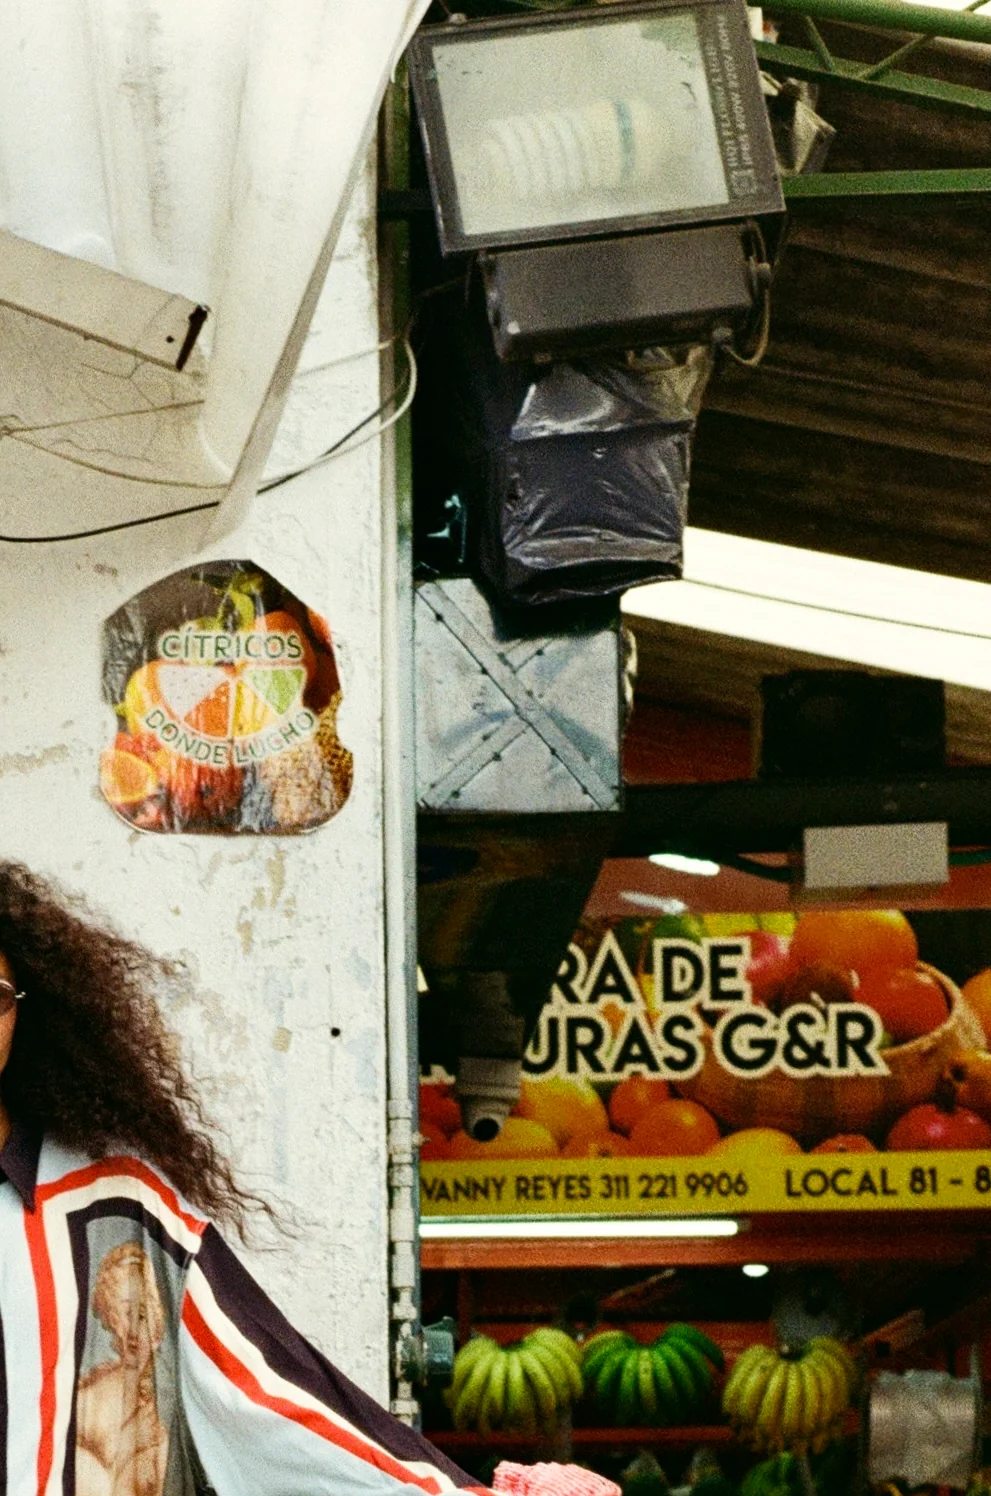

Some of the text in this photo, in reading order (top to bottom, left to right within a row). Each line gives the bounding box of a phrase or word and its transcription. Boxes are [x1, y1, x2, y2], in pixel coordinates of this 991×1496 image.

[160, 627, 304, 660] CÍTRICOS
[144, 708, 315, 765] DONDE LUCHO
[655, 939, 749, 1006] DE
[715, 1006, 886, 1078] G&R
[515, 1174, 592, 1200] REYES
[600, 1174, 630, 1199] 311
[638, 1173, 677, 1199] 221
[684, 1171, 749, 1197] 9906
[785, 1168, 898, 1198] LOCAL
[909, 1166, 939, 1195] 81
